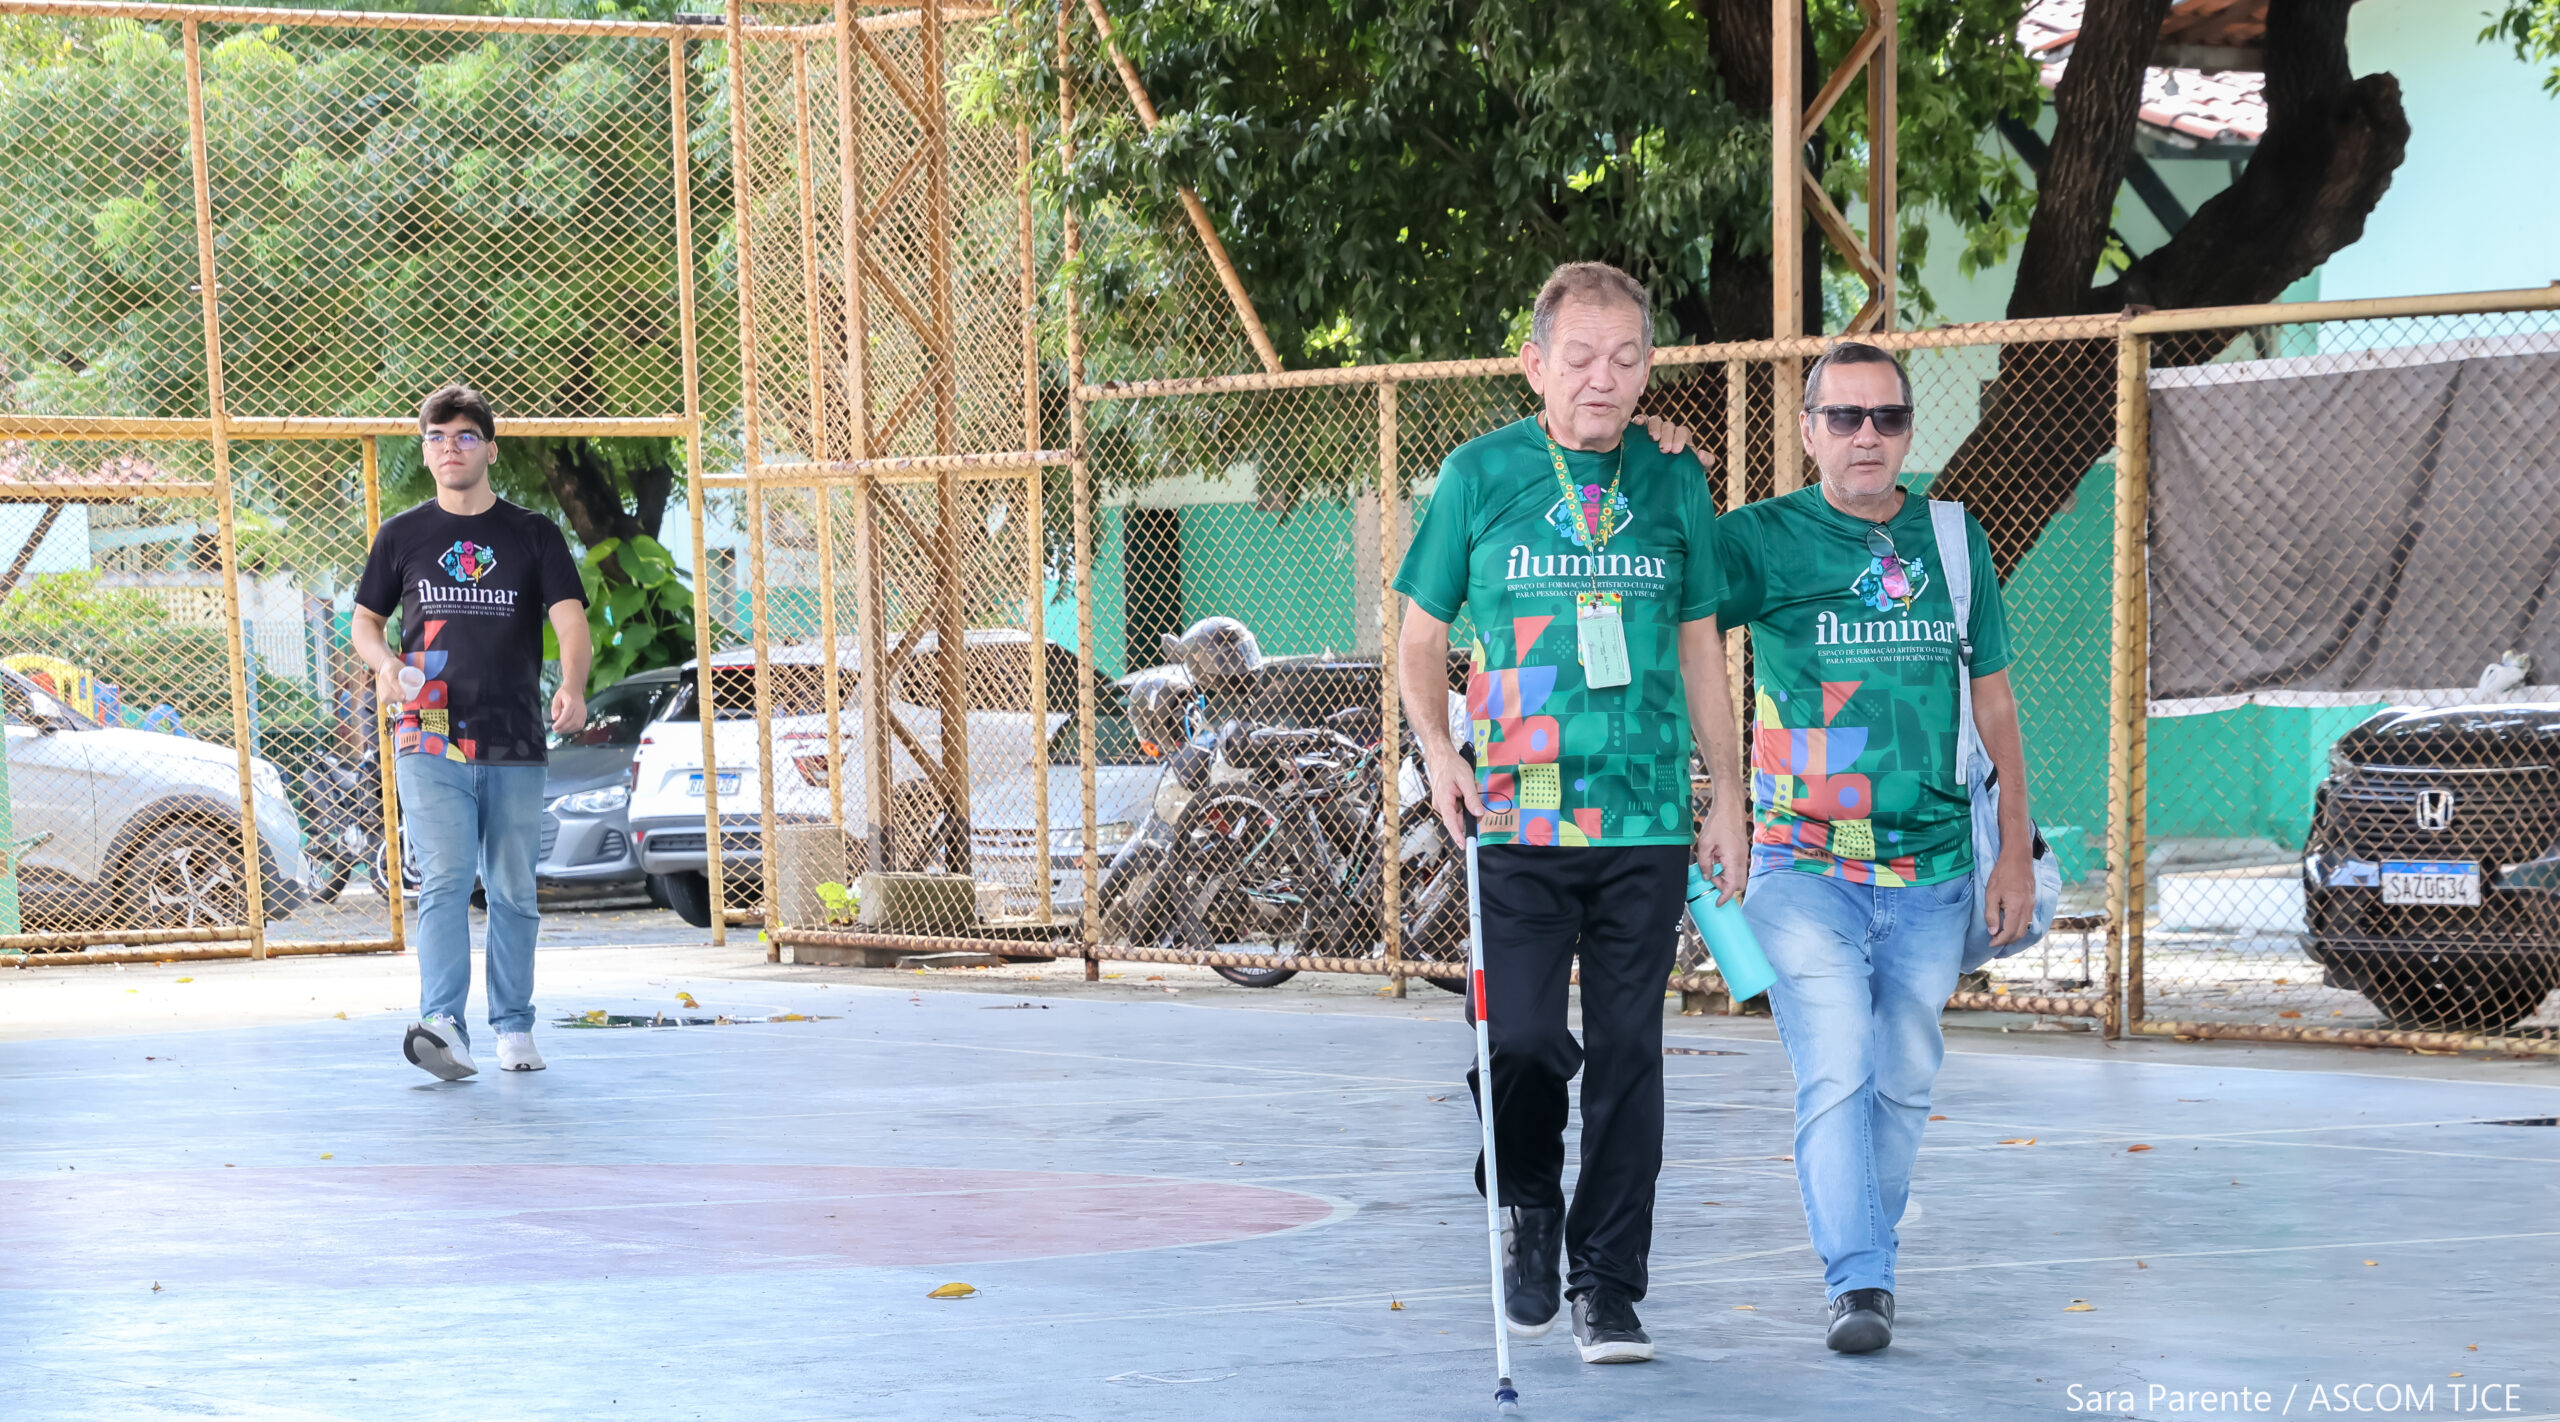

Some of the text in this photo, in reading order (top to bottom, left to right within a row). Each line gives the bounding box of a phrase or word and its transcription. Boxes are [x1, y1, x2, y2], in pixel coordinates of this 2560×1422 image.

[1505, 545, 1665, 579] iluminar
[418, 579, 518, 605] iluminar
[1549, 580, 1591, 589] FORMAÇÃO
[1515, 591, 1535, 599] PARA
[1815, 611, 1955, 645] iluminar
[1845, 648, 1856, 656] DE
[1856, 646, 1896, 655] FORMAÇÃO
